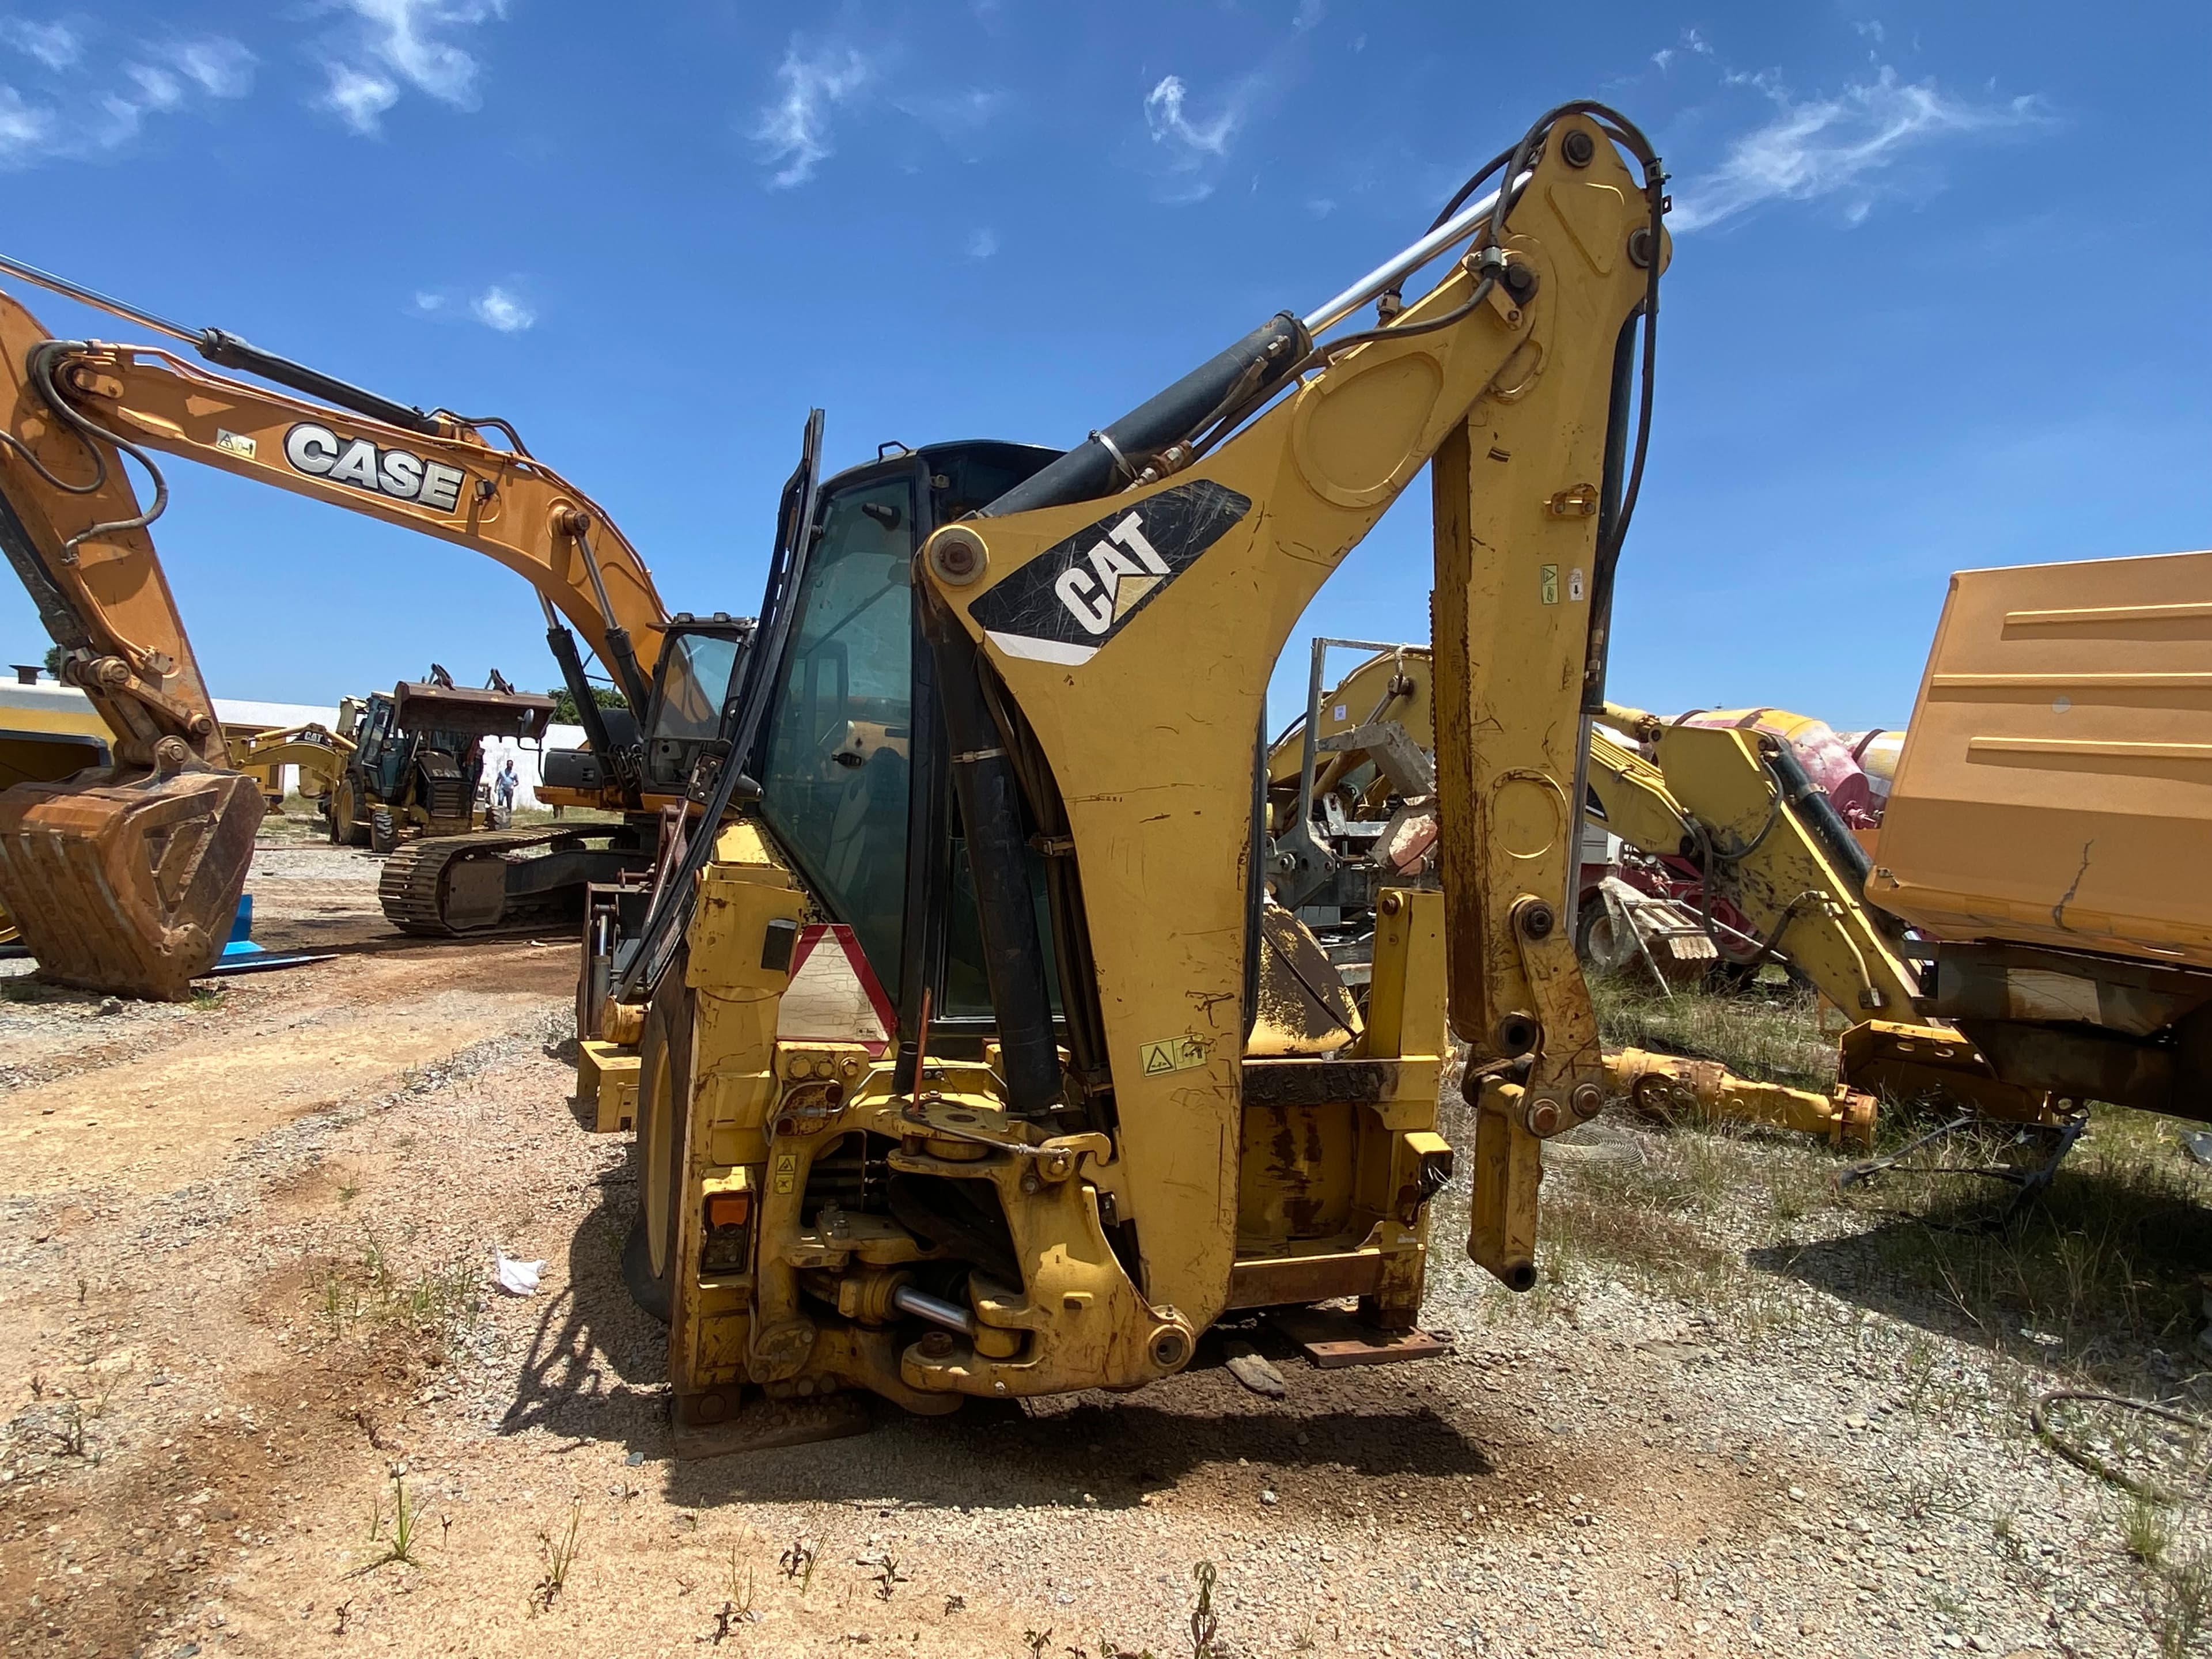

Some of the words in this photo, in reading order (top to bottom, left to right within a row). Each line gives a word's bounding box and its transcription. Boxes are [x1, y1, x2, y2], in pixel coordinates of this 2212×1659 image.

[288, 425, 465, 509] CASE
[1055, 511, 1171, 634] CAT
[304, 731, 323, 743] CAT
